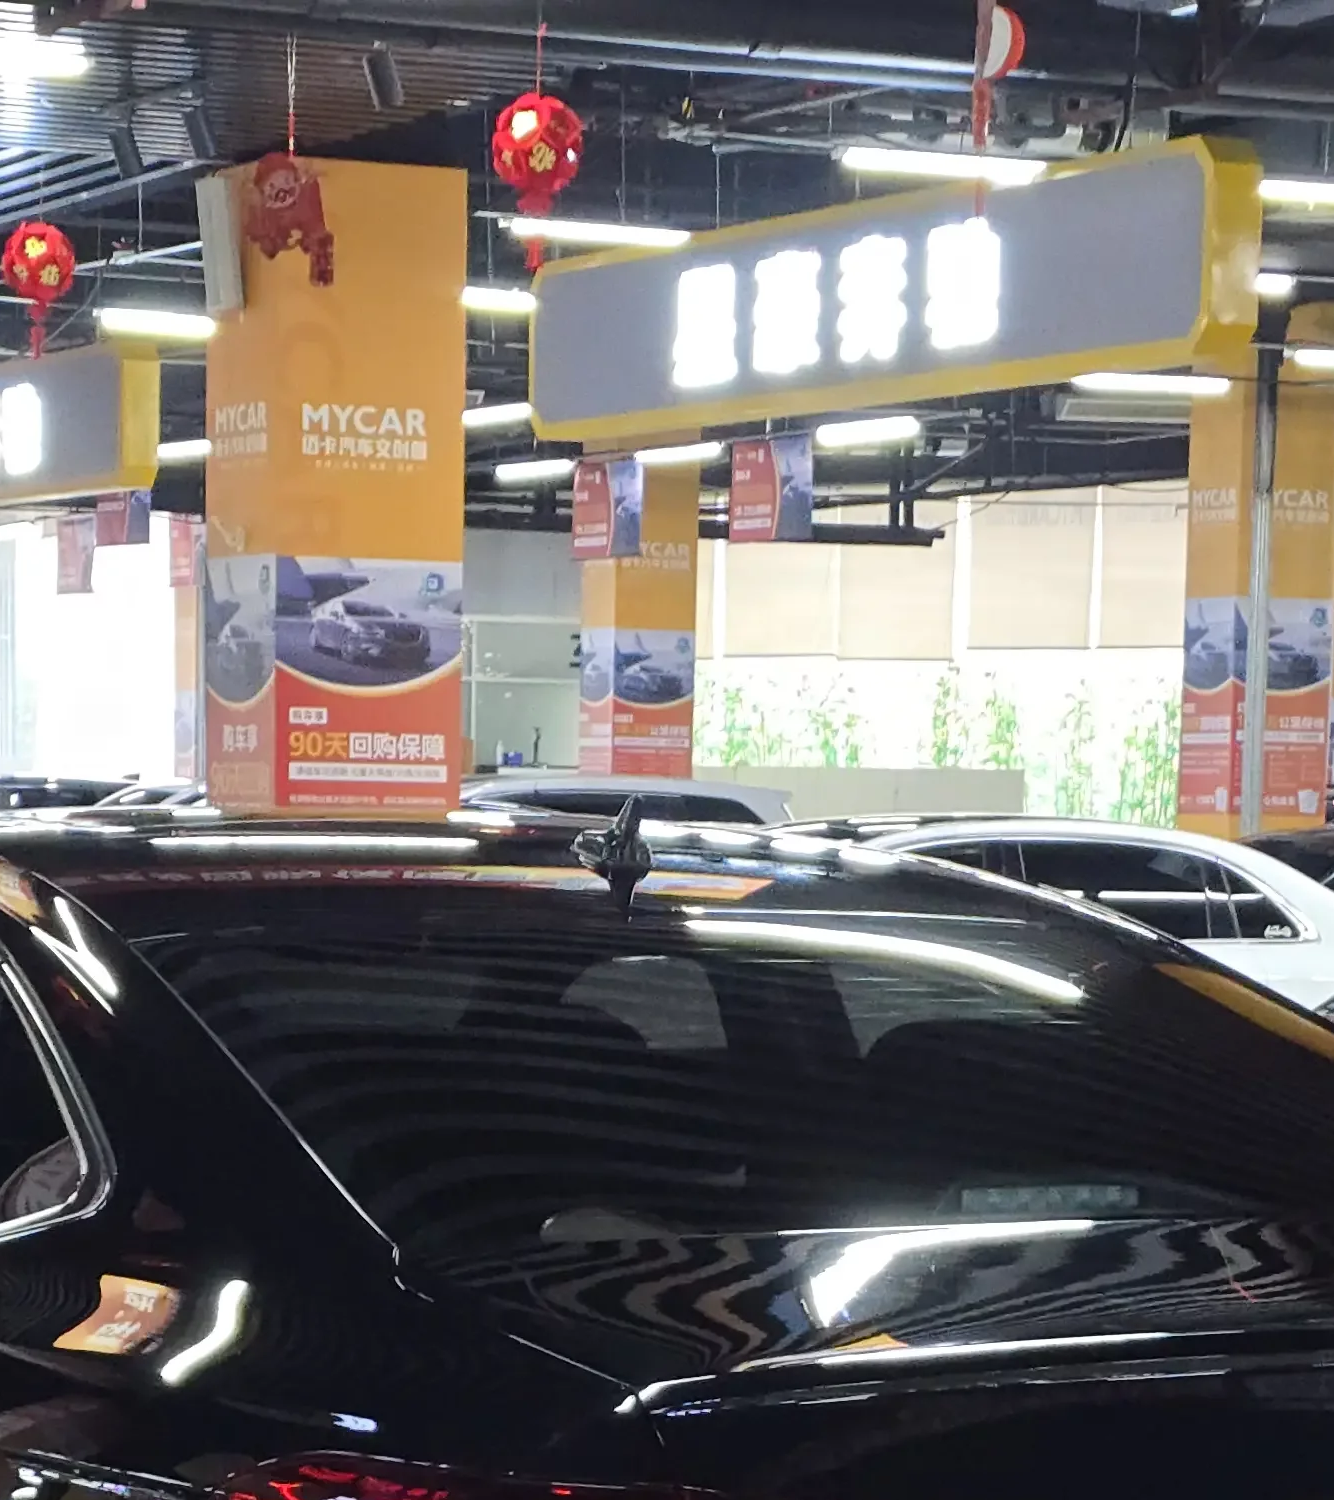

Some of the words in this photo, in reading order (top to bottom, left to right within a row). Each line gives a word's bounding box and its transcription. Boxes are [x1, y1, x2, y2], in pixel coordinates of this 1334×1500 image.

[301, 403, 427, 437] MYCAR
[1273, 489, 1329, 509] YCAR
[641, 542, 690, 559] YCAR
[289, 731, 445, 761] 90天回购保障
